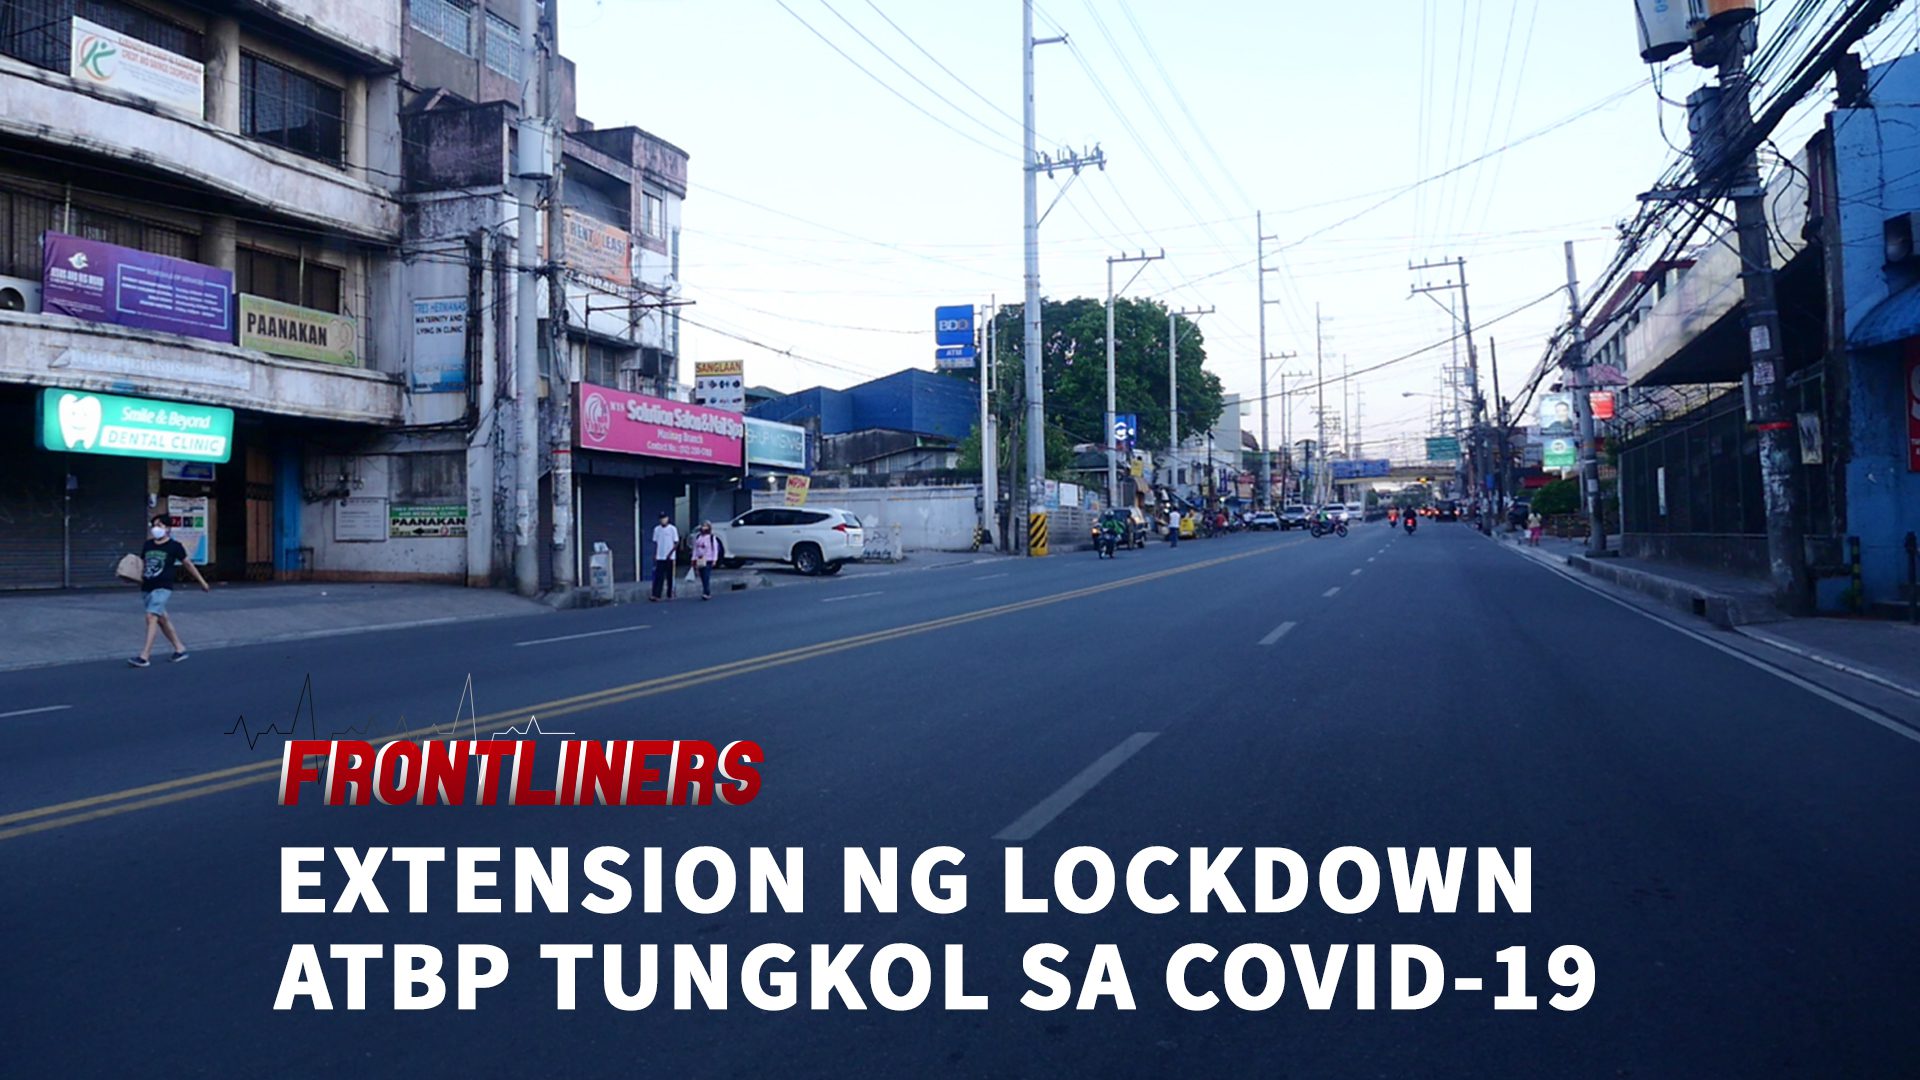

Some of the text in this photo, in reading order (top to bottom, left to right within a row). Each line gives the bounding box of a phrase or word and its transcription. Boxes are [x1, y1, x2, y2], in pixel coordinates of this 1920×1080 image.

[246, 311, 328, 347] PAANAKAN
[939, 319, 968, 331] BDO
[695, 361, 742, 373] SANGLAAN
[122, 407, 212, 431] Smile & Beyond
[626, 399, 674, 427] Solution
[108, 431, 219, 451] DENTAL CLINIC
[392, 518, 466, 526] PAANAKAN
